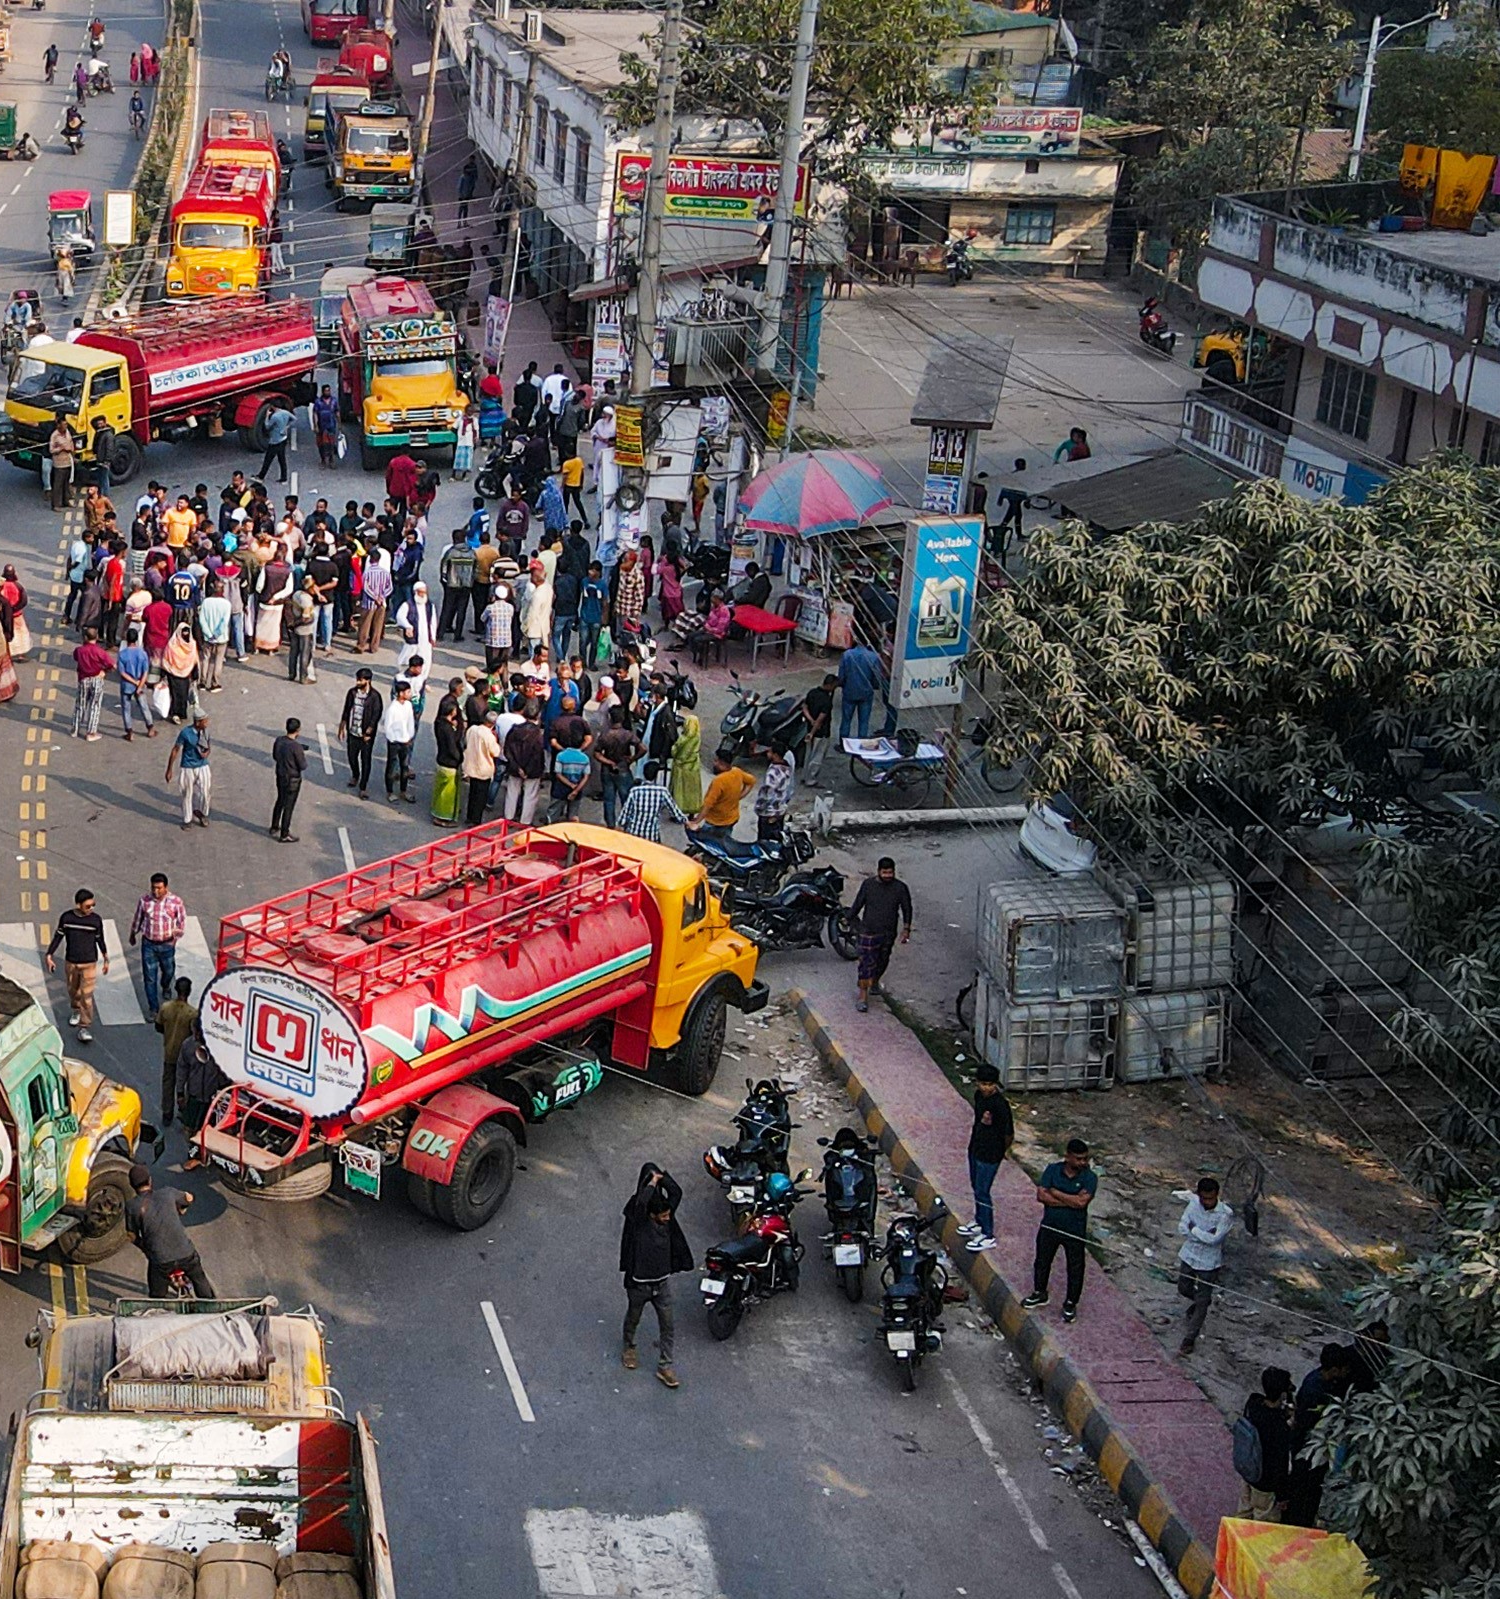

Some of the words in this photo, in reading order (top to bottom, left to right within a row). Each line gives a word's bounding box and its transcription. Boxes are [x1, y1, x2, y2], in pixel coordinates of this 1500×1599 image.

[1293, 460, 1335, 497] Mobil
[926, 537, 972, 550] Available
[911, 676, 944, 690] Mobil
[210, 991, 245, 1028] সাব
[321, 1027, 357, 1068] ধান
[555, 1079, 582, 1102] FUEL
[410, 1128, 457, 1161] OK
